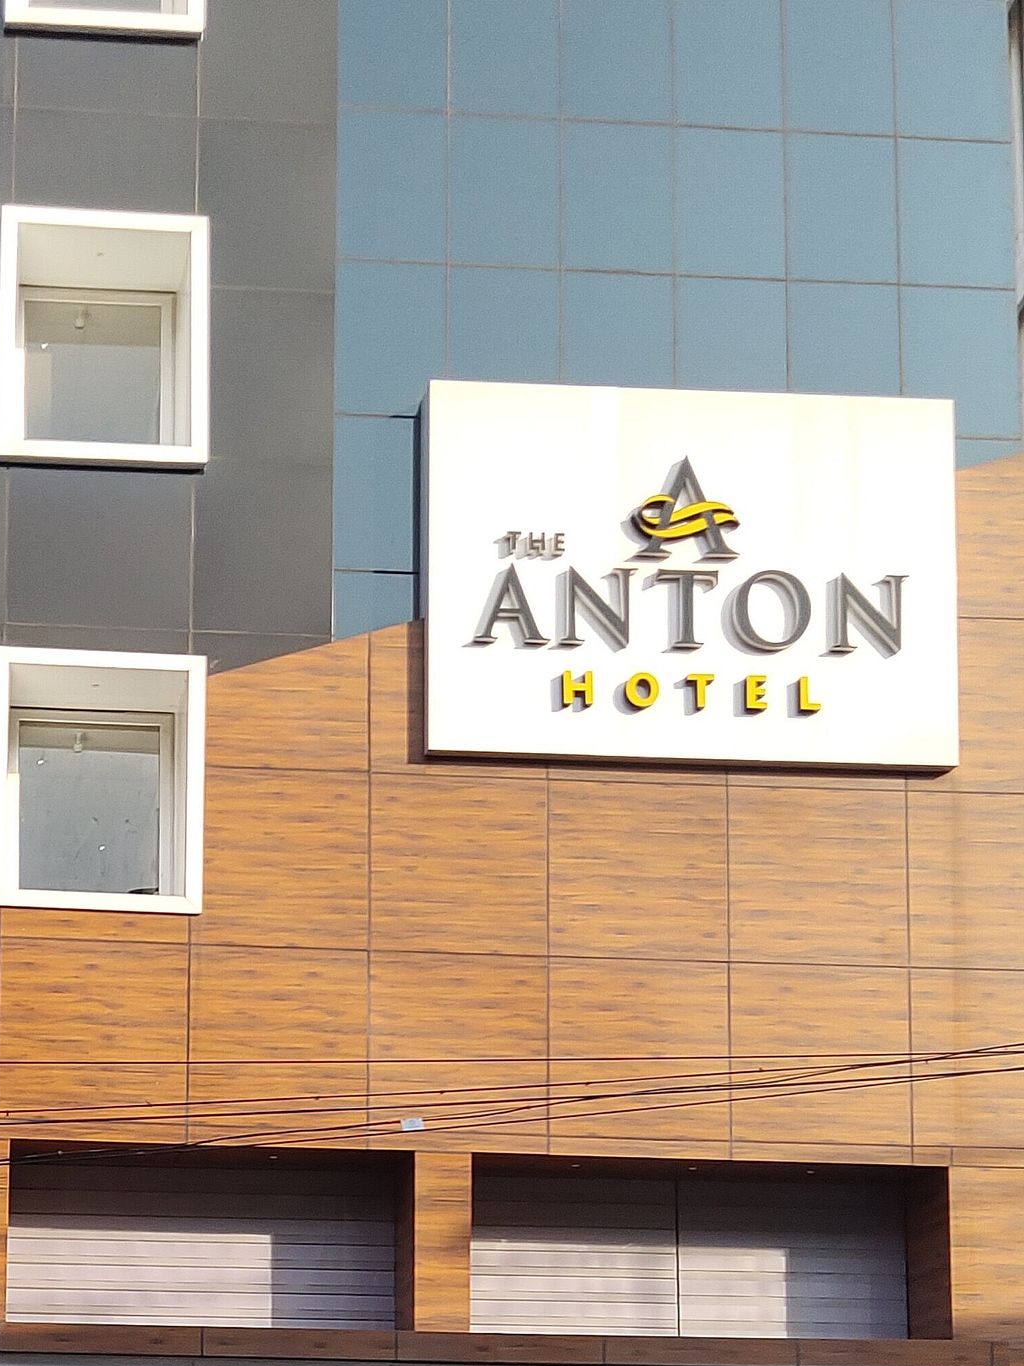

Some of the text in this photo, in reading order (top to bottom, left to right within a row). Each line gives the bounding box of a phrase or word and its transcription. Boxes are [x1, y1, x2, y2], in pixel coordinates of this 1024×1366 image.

[499, 531, 566, 557] THE
[466, 563, 910, 657] ANTON
[556, 670, 821, 714] HOTEL
